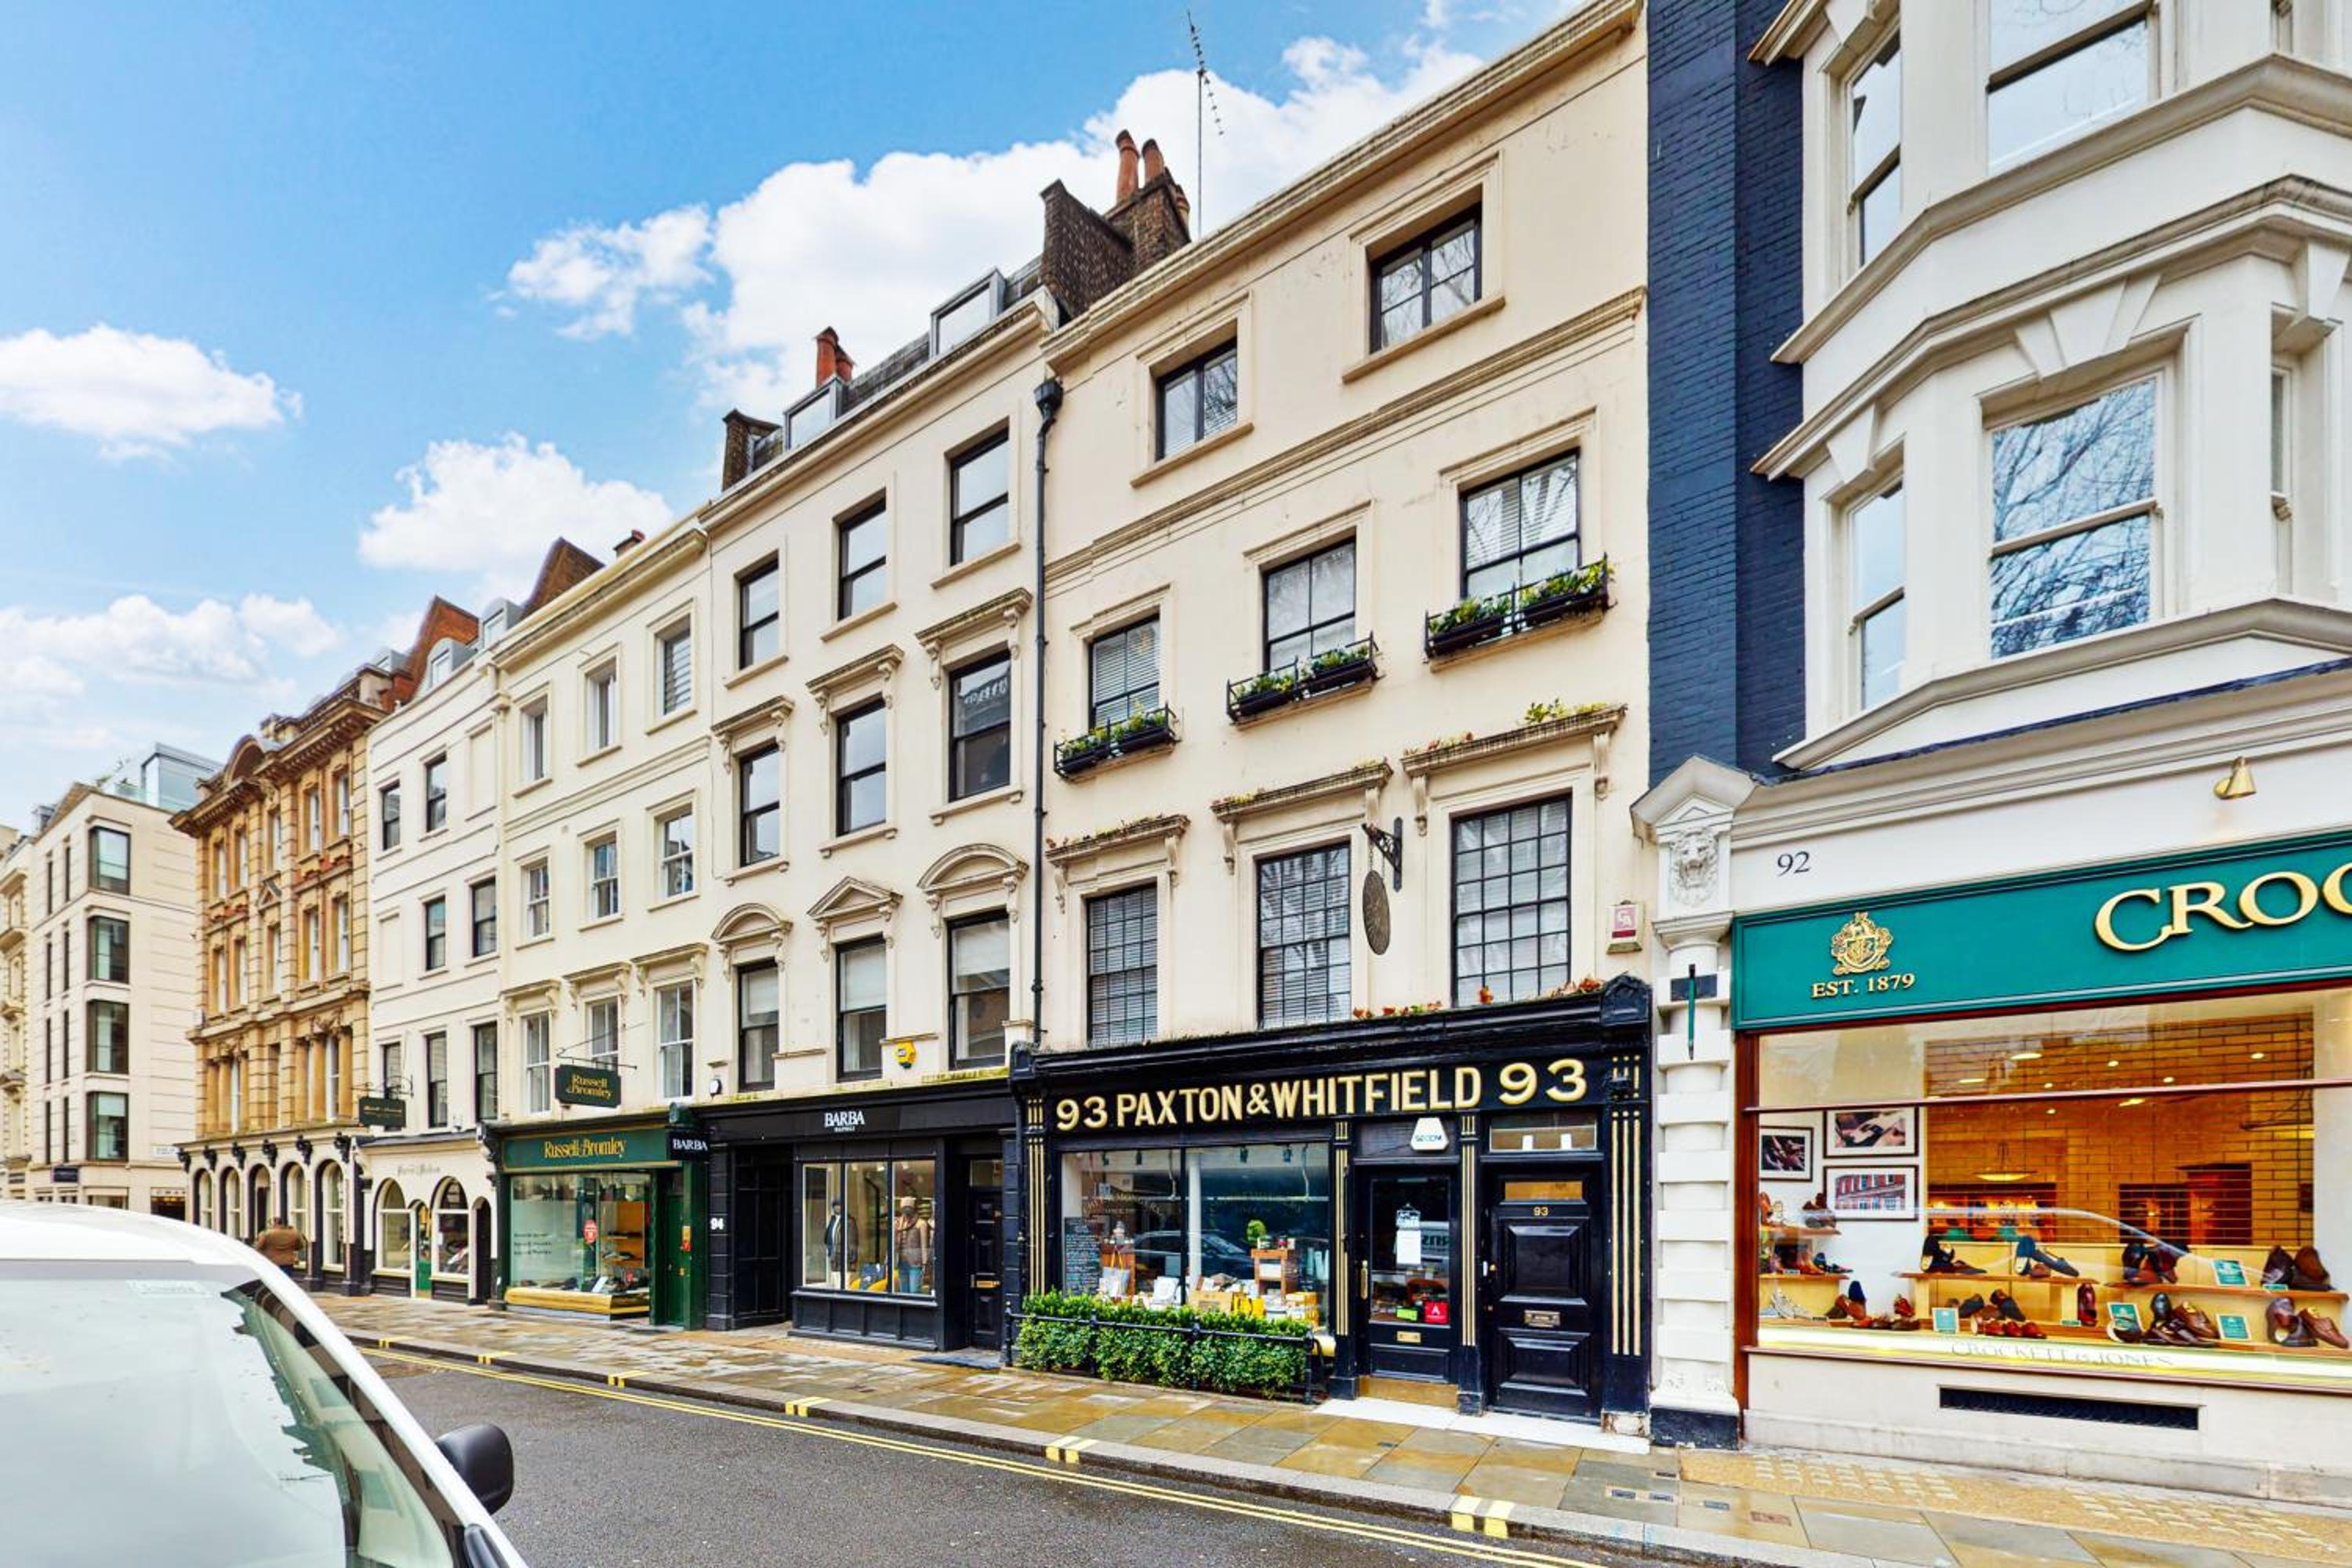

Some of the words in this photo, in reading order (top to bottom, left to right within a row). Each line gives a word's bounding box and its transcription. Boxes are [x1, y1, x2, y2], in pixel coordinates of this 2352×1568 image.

[1777, 851, 1812, 877] 92
[1812, 978, 1859, 999] EST.
[1867, 973, 1915, 993] 1879
[572, 1073, 608, 1088] Russell
[1056, 1095, 1109, 1131] 93
[1498, 1058, 1588, 1105] 93
[824, 1110, 866, 1127] BARBA
[673, 1138, 708, 1151] BARBA
[1533, 1206, 1549, 1216] 93
[710, 1218, 724, 1230] 94
